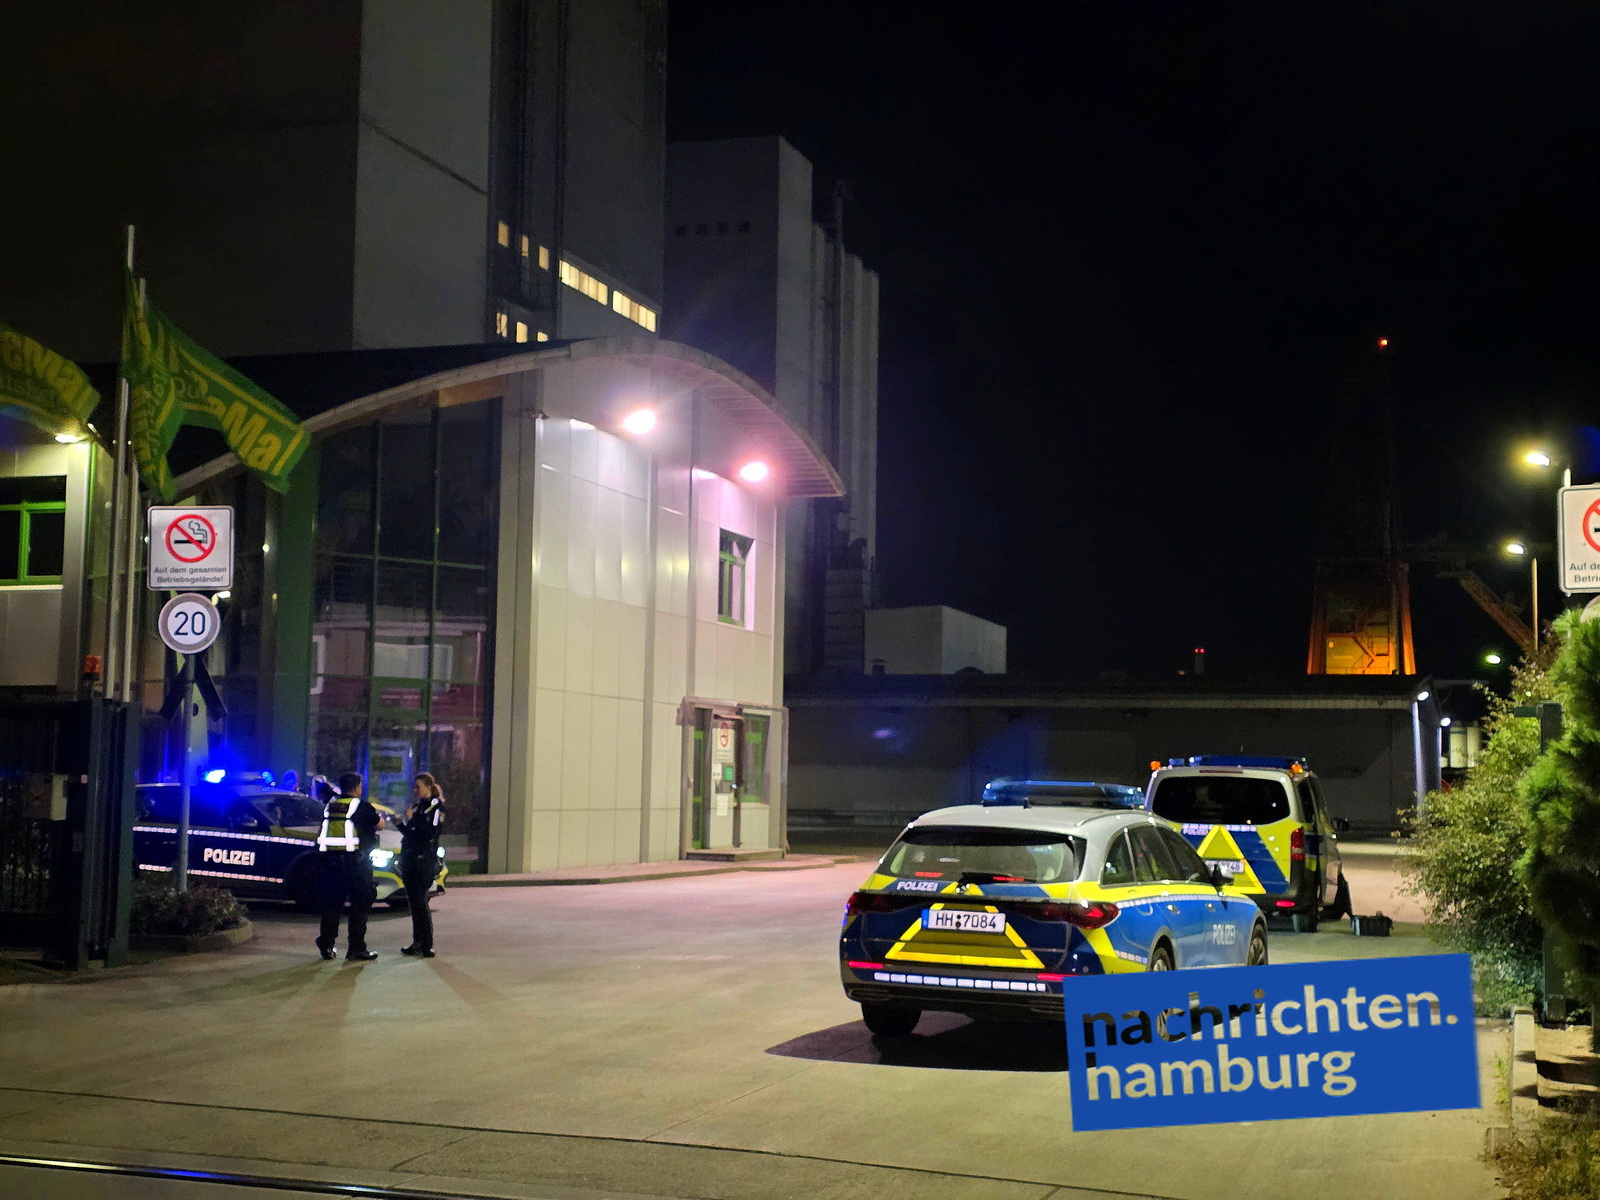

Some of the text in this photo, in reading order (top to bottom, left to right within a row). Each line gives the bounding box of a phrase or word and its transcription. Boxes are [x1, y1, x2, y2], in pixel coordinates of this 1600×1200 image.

[1570, 562, 1586, 570] Auf
[1574, 574, 1600, 582] Betri
[173, 611, 206, 636] 20
[203, 847, 256, 866] POLIZEI
[896, 881, 939, 893] POLIZEI
[1213, 924, 1235, 945] POLIZEI
